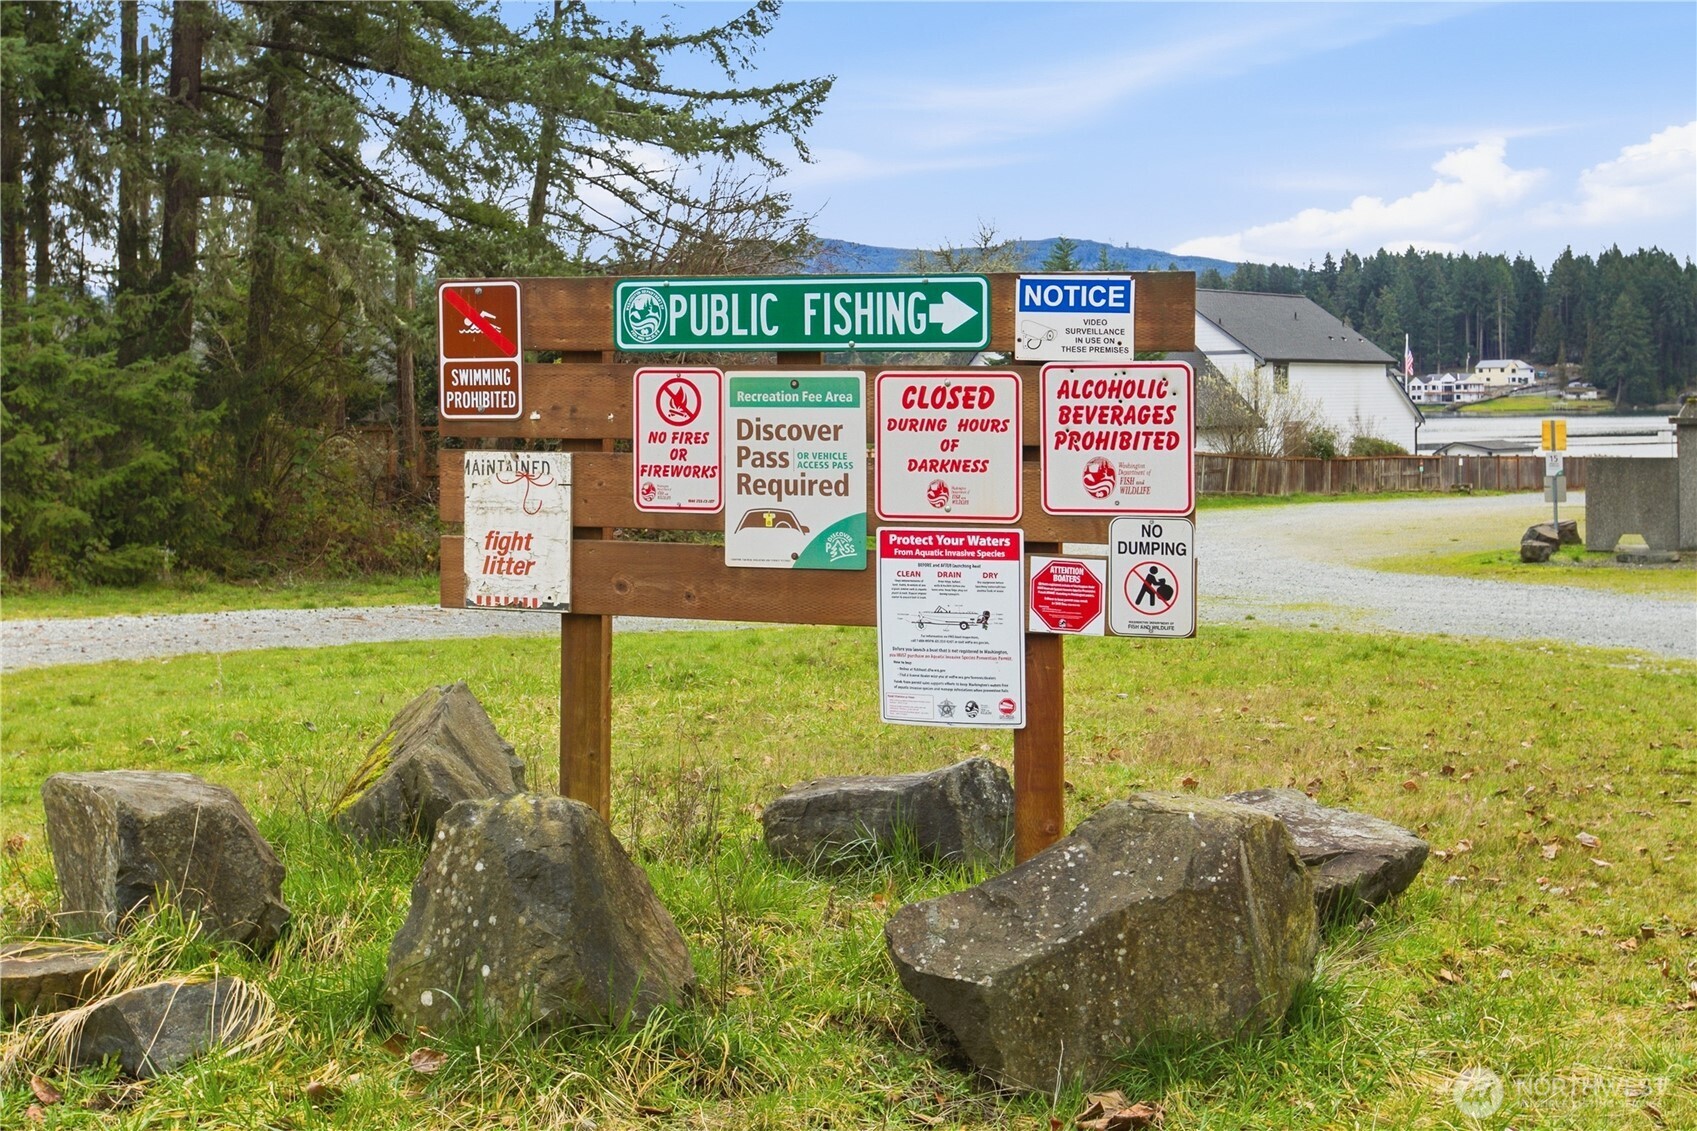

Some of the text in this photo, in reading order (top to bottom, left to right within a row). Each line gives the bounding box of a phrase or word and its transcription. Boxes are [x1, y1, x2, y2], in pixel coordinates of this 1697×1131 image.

[1024, 285, 1124, 307] NOTICE
[669, 293, 778, 336] PUBLIC
[804, 291, 927, 335] FISHING
[451, 368, 511, 386] SWIMMING
[737, 391, 852, 402] Recreation Fee Area
[1057, 379, 1168, 399] ALCOHOLIC
[446, 391, 516, 408] PROHIBITED
[902, 386, 994, 409] CLOSED
[1059, 405, 1176, 426] BEVERAGES
[737, 418, 843, 441] Discover
[887, 418, 1010, 432] DURING HOURS
[648, 432, 709, 445] NO FIRES
[940, 439, 959, 452] OF
[1054, 431, 1180, 451] PROHIBITED
[670, 449, 687, 461] OR
[737, 446, 789, 468] Pass
[640, 465, 717, 478] FIREWORKS
[907, 459, 989, 473] DARKNESS
[737, 472, 849, 502] Required
[1120, 486, 1151, 494] WILDLIFE
[827, 532, 853, 542] DISCOVER
[1142, 524, 1162, 538] NO
[485, 531, 534, 556] fight
[889, 534, 1010, 546] Protect Your Waters
[1118, 541, 1186, 556] DUMPING
[482, 556, 536, 575] litter
[1050, 566, 1084, 575] ATTENTION
[1053, 575, 1080, 583] BOATERS
